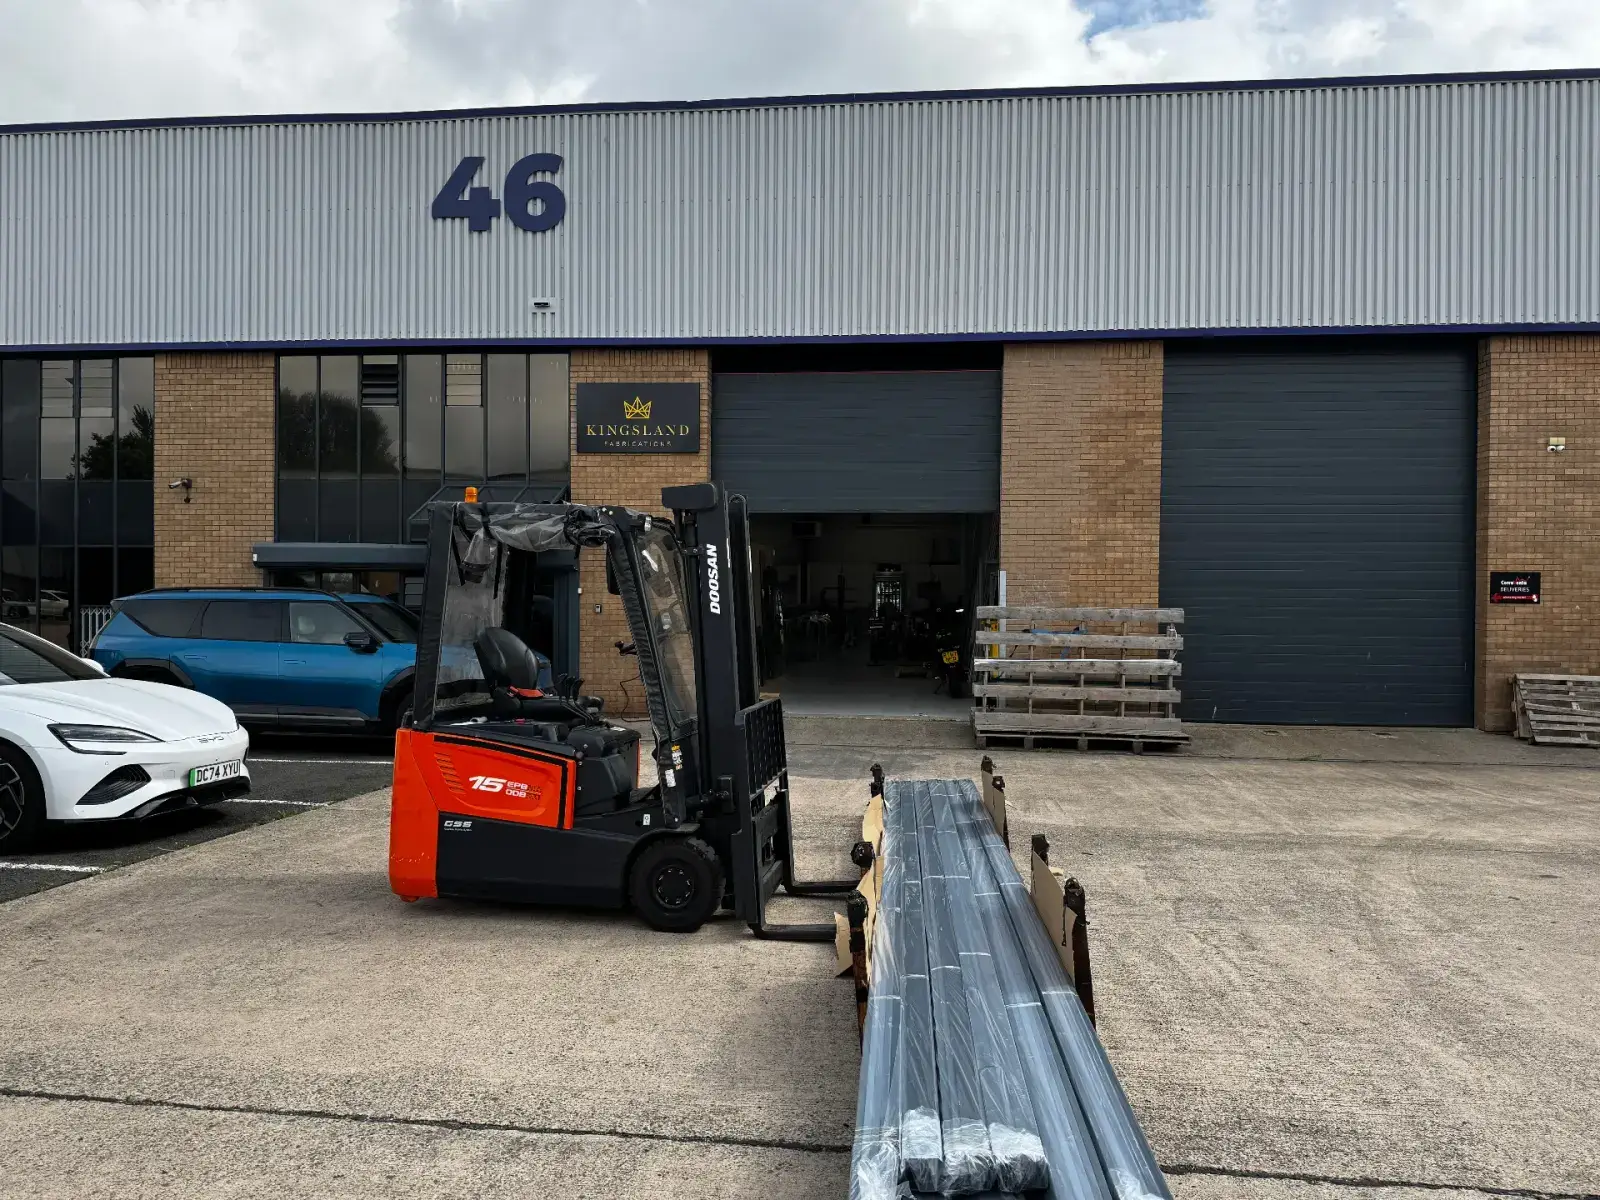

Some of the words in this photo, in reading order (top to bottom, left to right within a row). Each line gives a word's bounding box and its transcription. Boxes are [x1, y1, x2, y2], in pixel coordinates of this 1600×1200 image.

[431, 152, 566, 232] 46
[586, 424, 690, 436] KINGSLAND
[604, 440, 673, 448] FABRICATIONS
[705, 543, 721, 615] DOOSAN
[196, 765, 221, 783] DC74
[222, 761, 239, 777] XYU
[468, 775, 507, 793] 15
